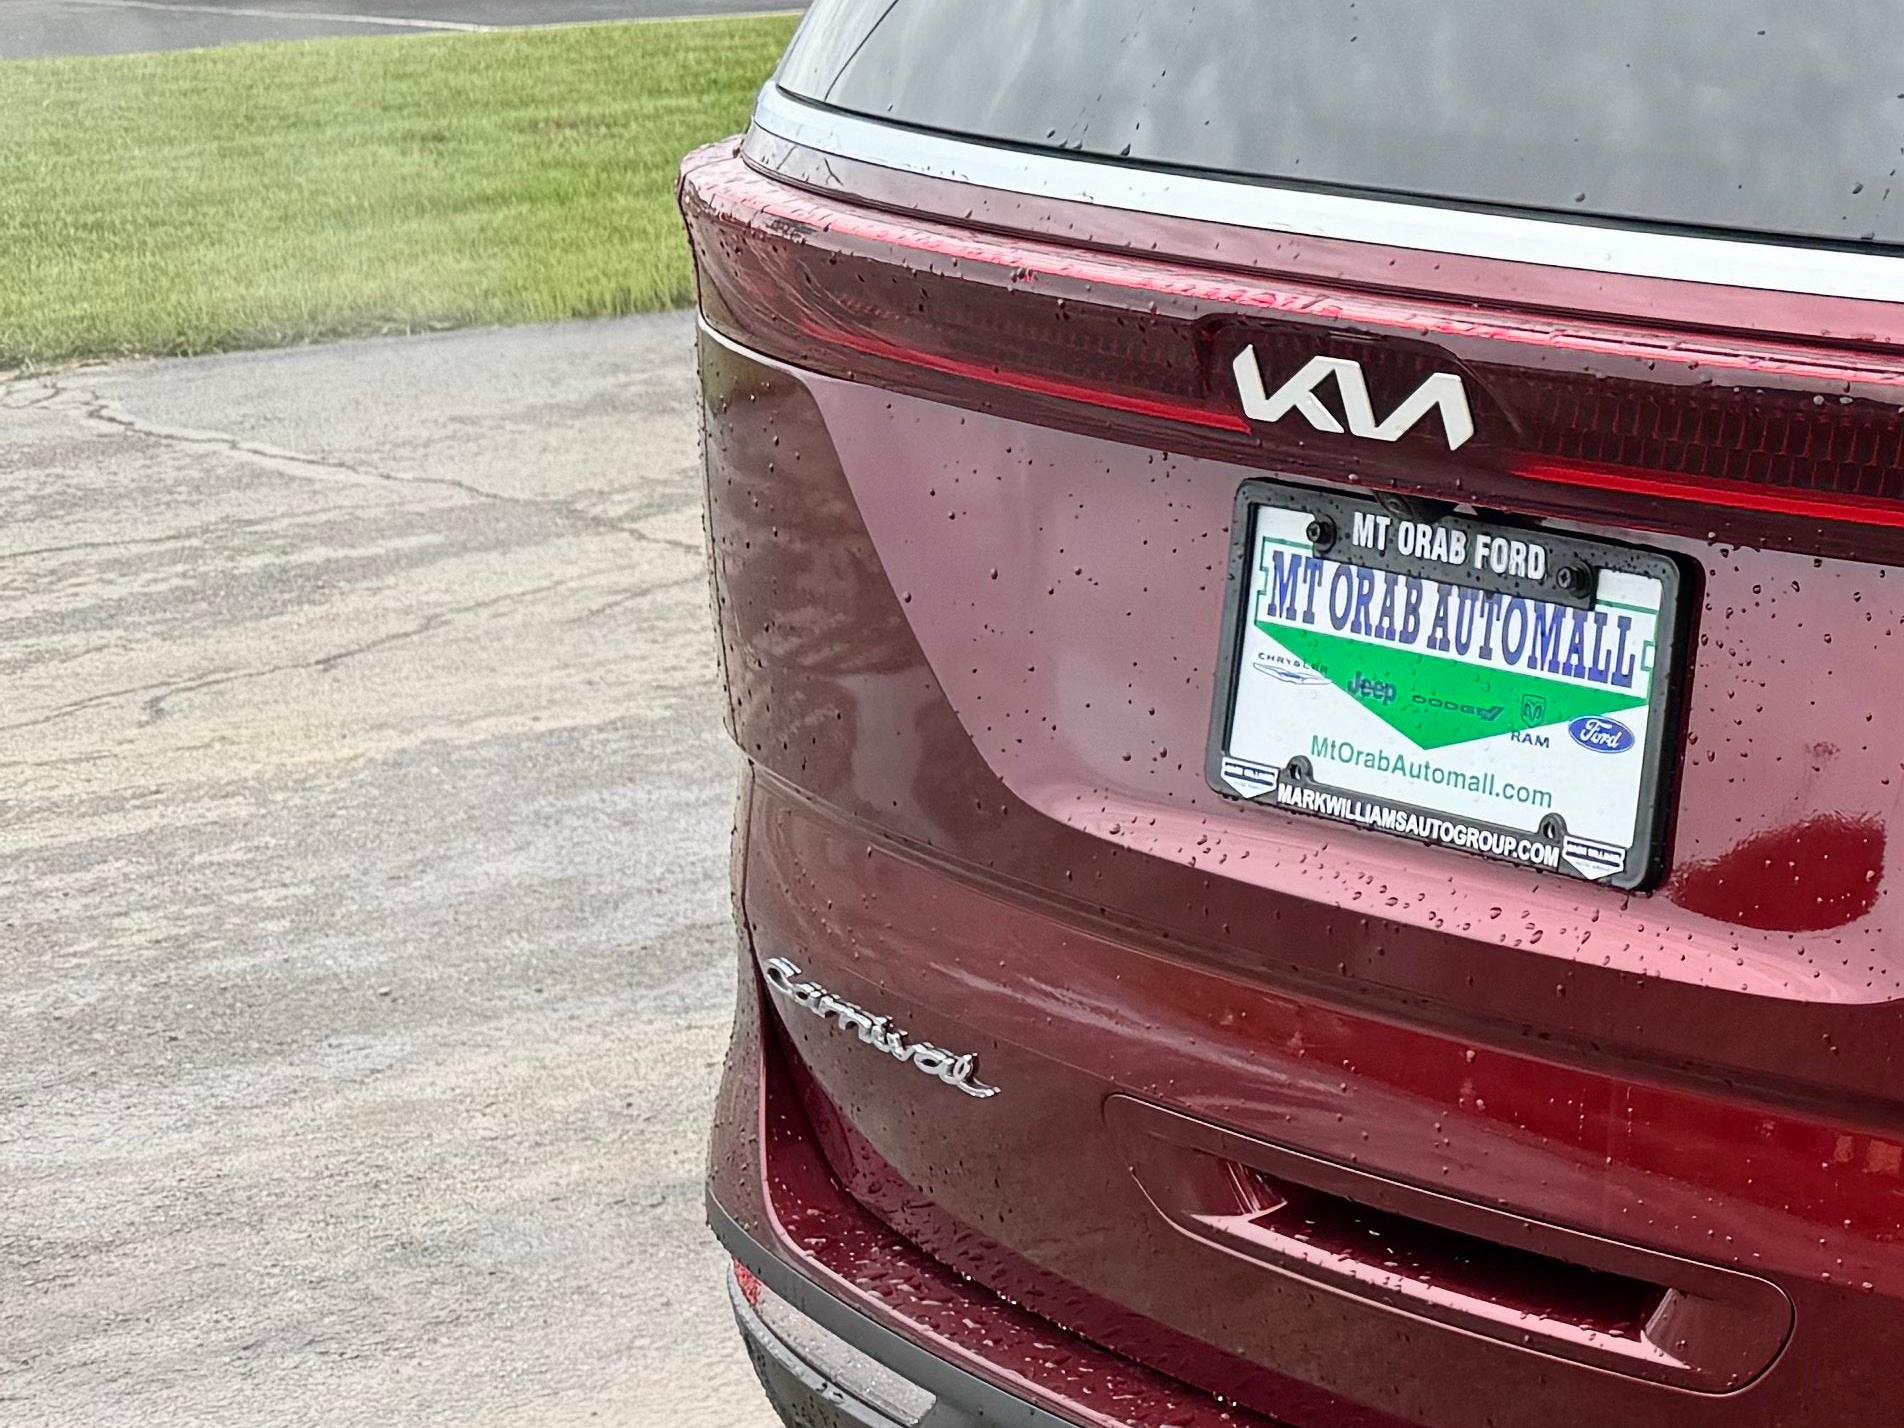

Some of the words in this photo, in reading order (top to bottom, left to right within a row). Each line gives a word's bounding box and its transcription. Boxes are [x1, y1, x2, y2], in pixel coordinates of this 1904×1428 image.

[1232, 344, 1475, 451] KIA
[1352, 512, 1392, 551] MT
[1398, 521, 1466, 566] ORAB
[1474, 533, 1547, 581] FORD
[1267, 550, 1325, 625] MT
[1329, 564, 1422, 646] ORAB
[1426, 580, 1636, 689] AUTOMALL
[1347, 670, 1398, 706] Jeep
[1510, 729, 1550, 749] RAM
[1580, 720, 1621, 748] Ford
[1310, 734, 1554, 809] MtOrabAutomall.com
[1277, 783, 1560, 868] MARKWILLIAMSAUTOGROUP.COM
